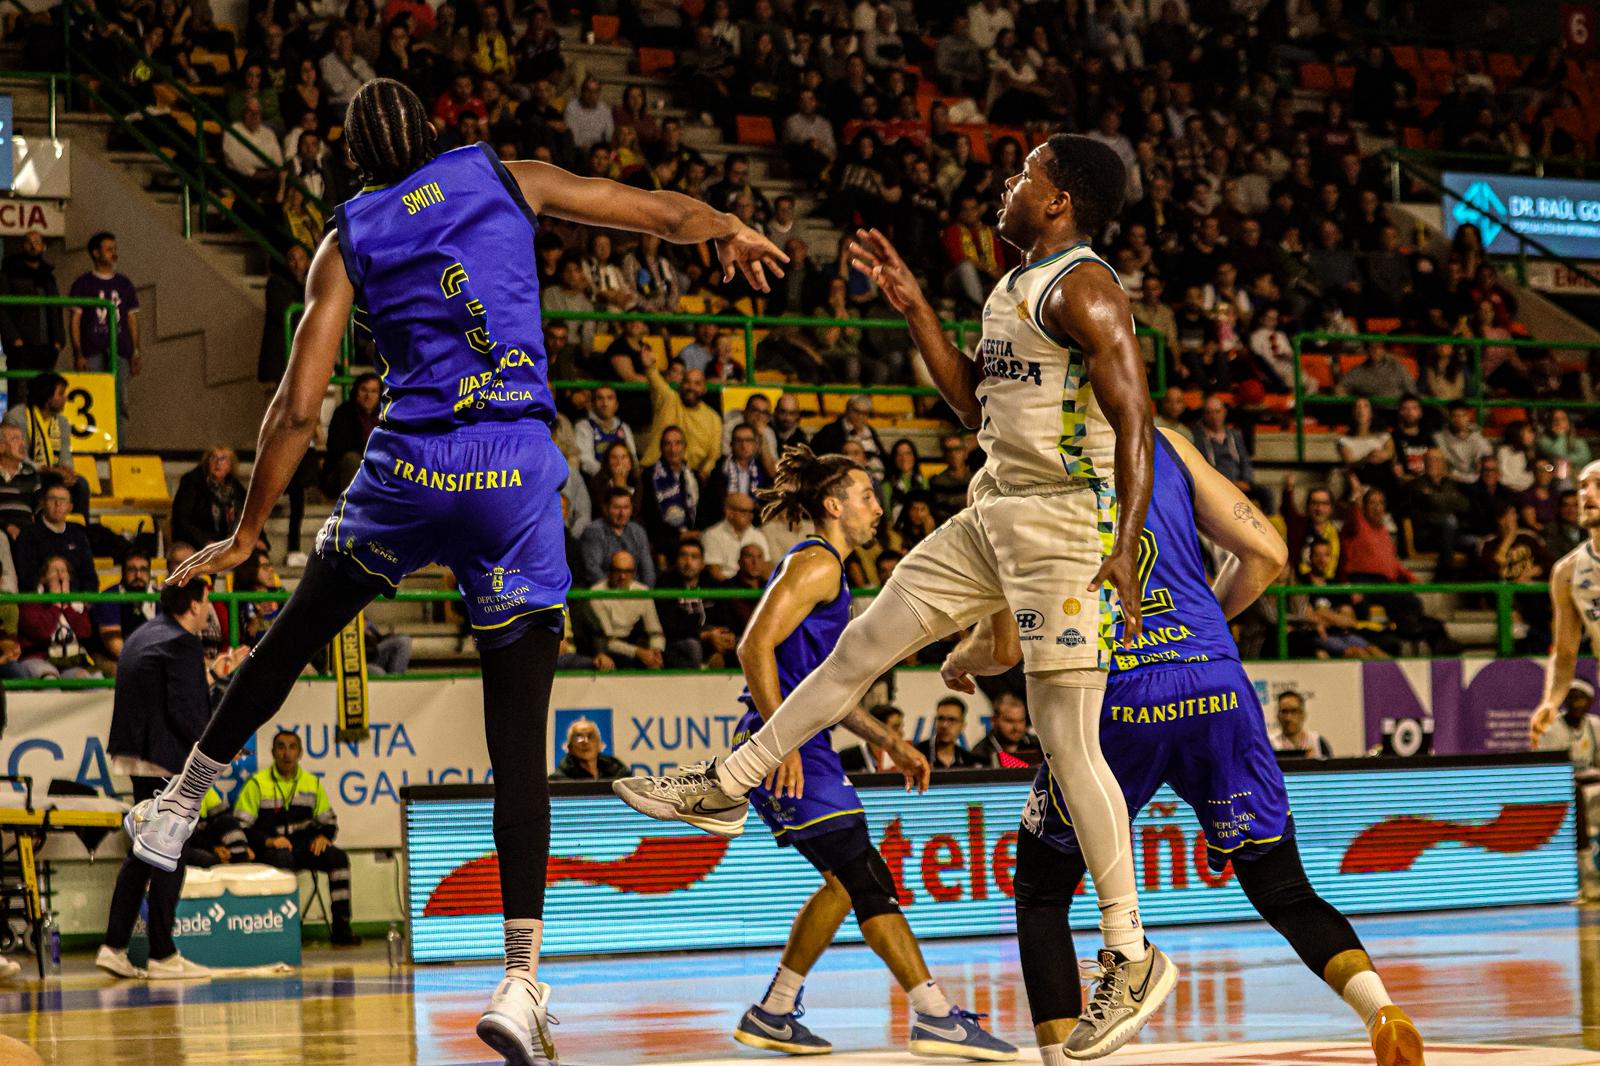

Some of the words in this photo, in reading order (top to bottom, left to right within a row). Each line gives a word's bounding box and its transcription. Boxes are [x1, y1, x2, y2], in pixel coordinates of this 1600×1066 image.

[1570, 13, 1588, 45] 6
[401, 181, 445, 215] SMITH
[67, 388, 97, 438] 3
[484, 595, 528, 613] OURENSE
[1111, 691, 1239, 724] TRANSITERIA
[631, 715, 738, 751] XUNT
[173, 913, 212, 938] gade
[228, 909, 284, 934] ingade
